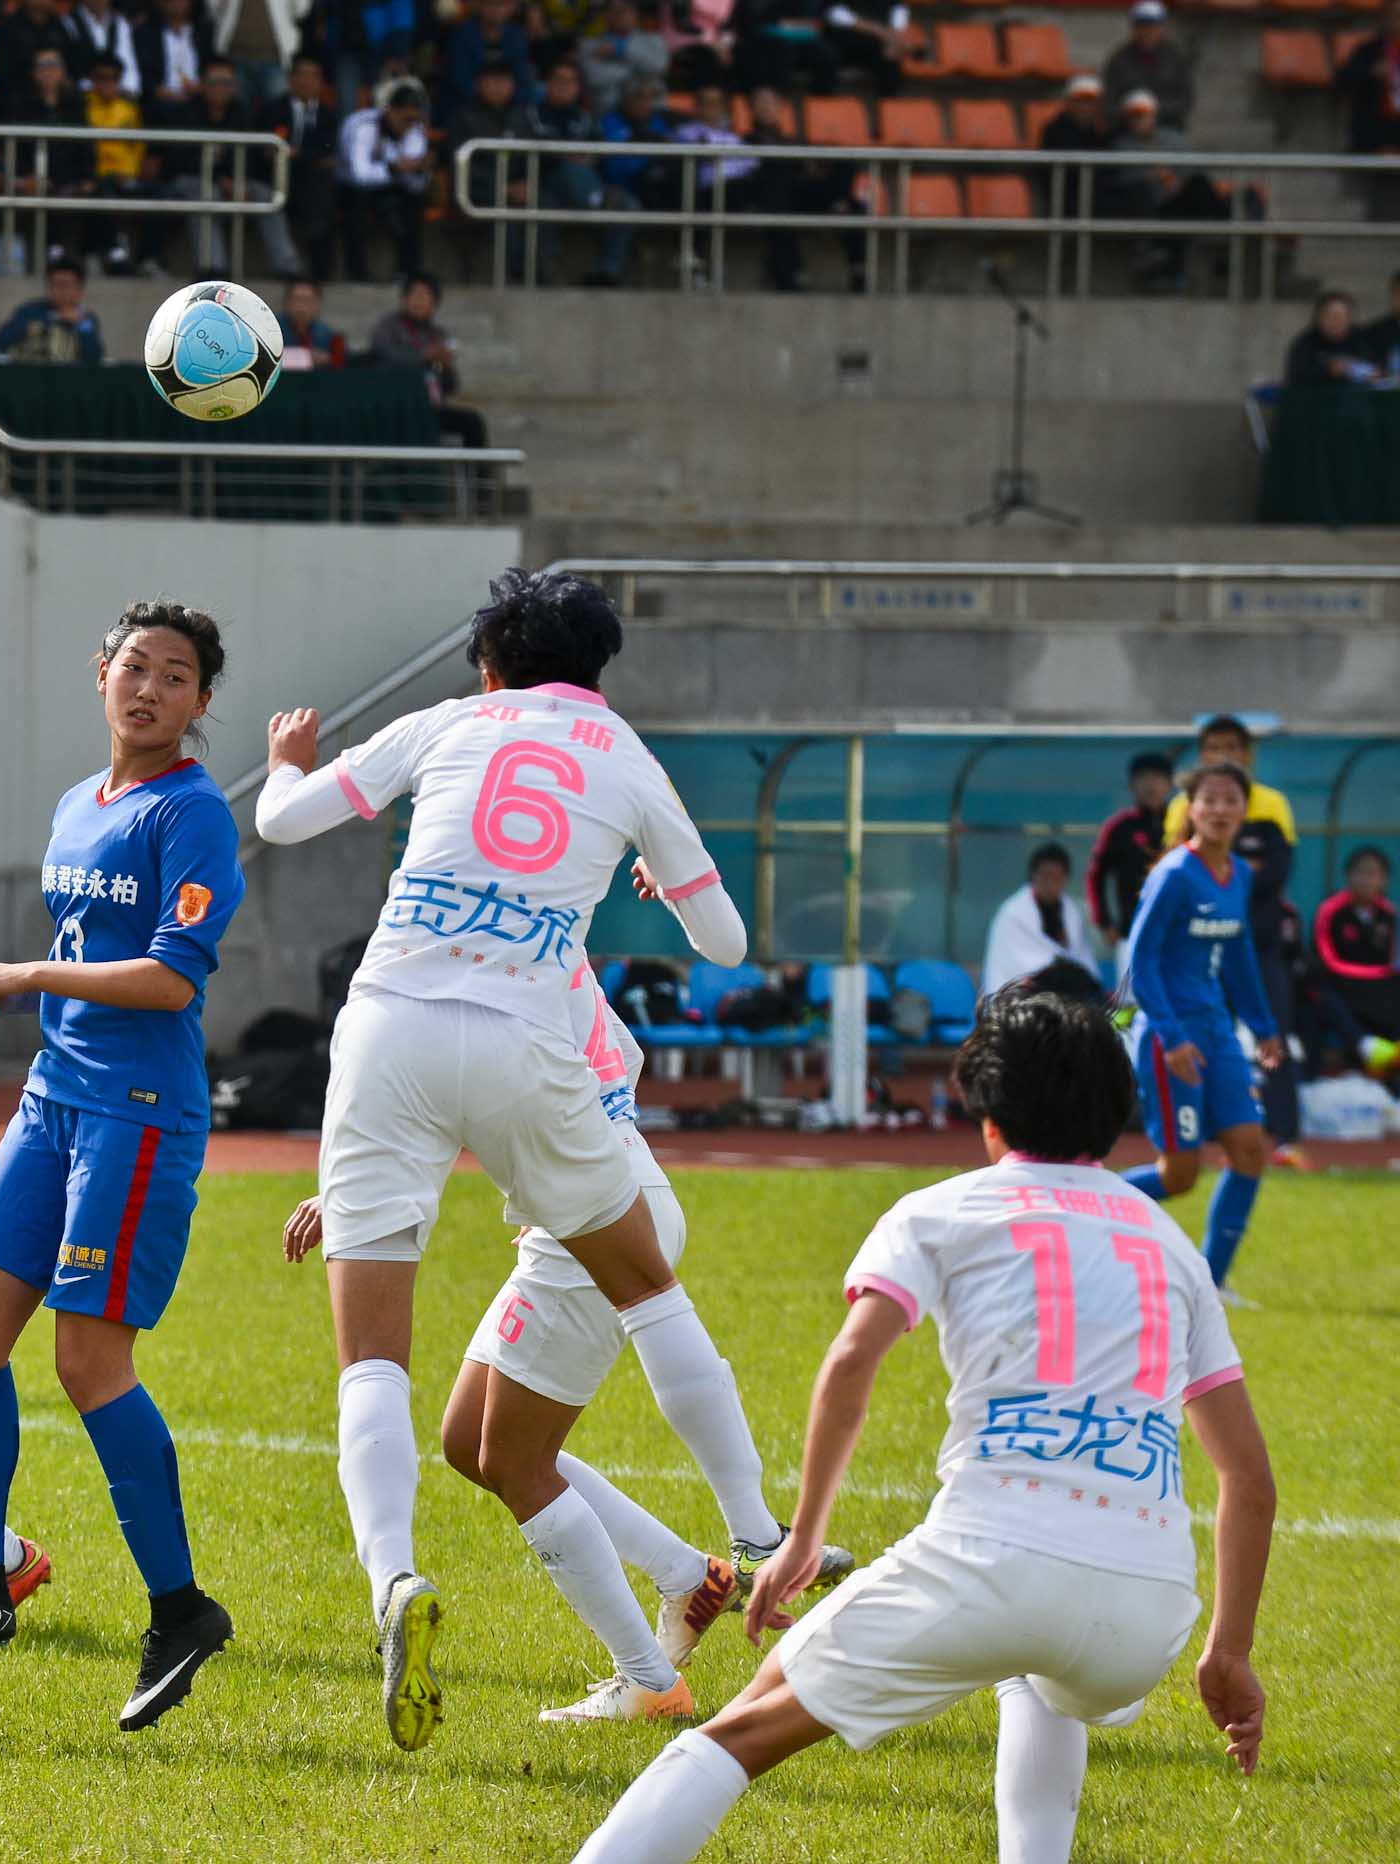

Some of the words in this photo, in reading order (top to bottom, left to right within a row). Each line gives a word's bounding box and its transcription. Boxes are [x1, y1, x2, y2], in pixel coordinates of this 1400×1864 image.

[471, 739, 585, 875] 6
[42, 863, 139, 905] 泰君安永柏
[1178, 1105, 1199, 1142] 9
[75, 1246, 106, 1264] 诚信
[498, 1296, 534, 1344] 6
[1010, 1222, 1170, 1402] 11
[684, 1556, 733, 1634] NIKE
